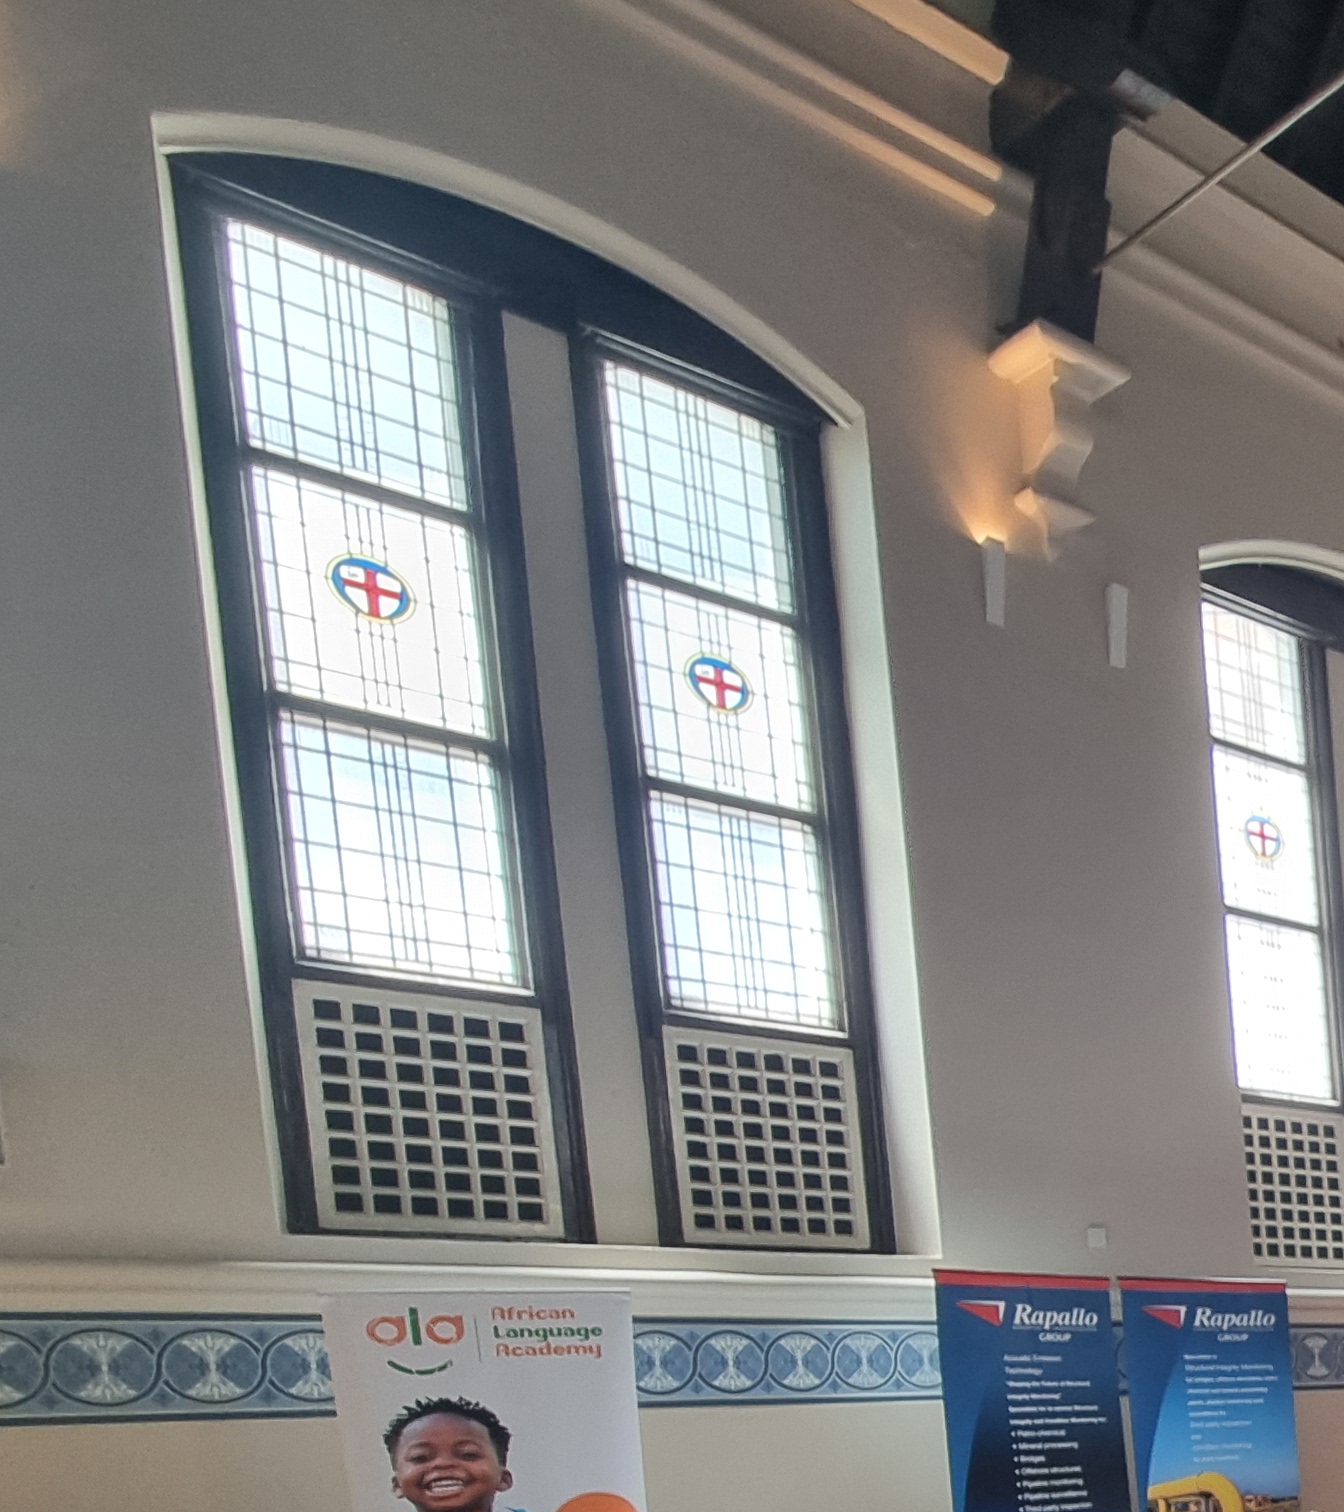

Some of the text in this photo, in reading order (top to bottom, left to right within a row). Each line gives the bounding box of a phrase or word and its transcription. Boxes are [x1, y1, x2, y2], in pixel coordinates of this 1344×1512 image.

[491, 1305, 576, 1321] African
[1013, 1303, 1099, 1330] Rapallo
[1193, 1306, 1276, 1331] Rapallo
[493, 1325, 603, 1342] Language
[495, 1342, 604, 1359] Academy
